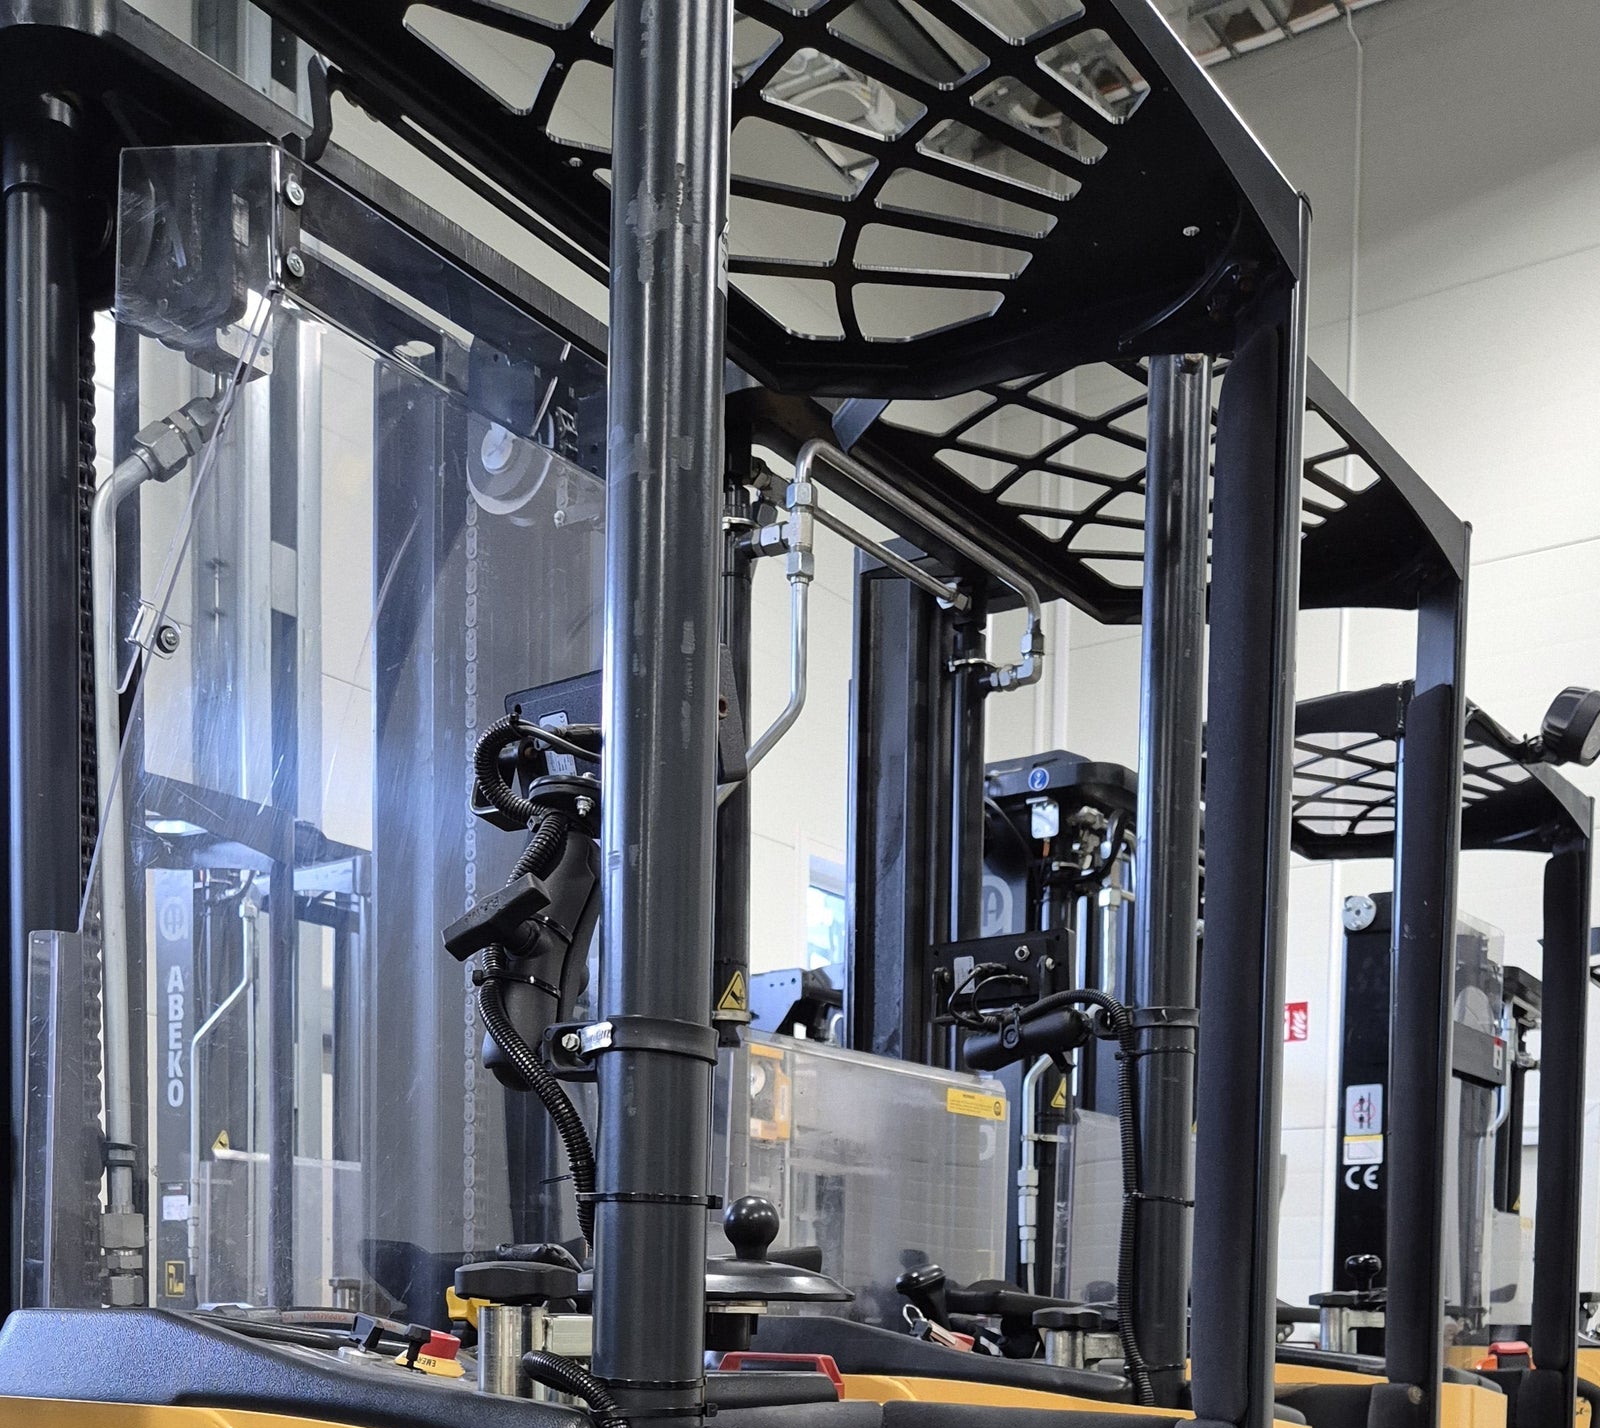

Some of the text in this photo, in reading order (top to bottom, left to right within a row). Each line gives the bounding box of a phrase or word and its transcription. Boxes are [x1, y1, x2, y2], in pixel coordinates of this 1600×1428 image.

[166, 965, 185, 1108] ABEKO
[1344, 1164, 1380, 1191] CE
[416, 1356, 437, 1369] EMER
